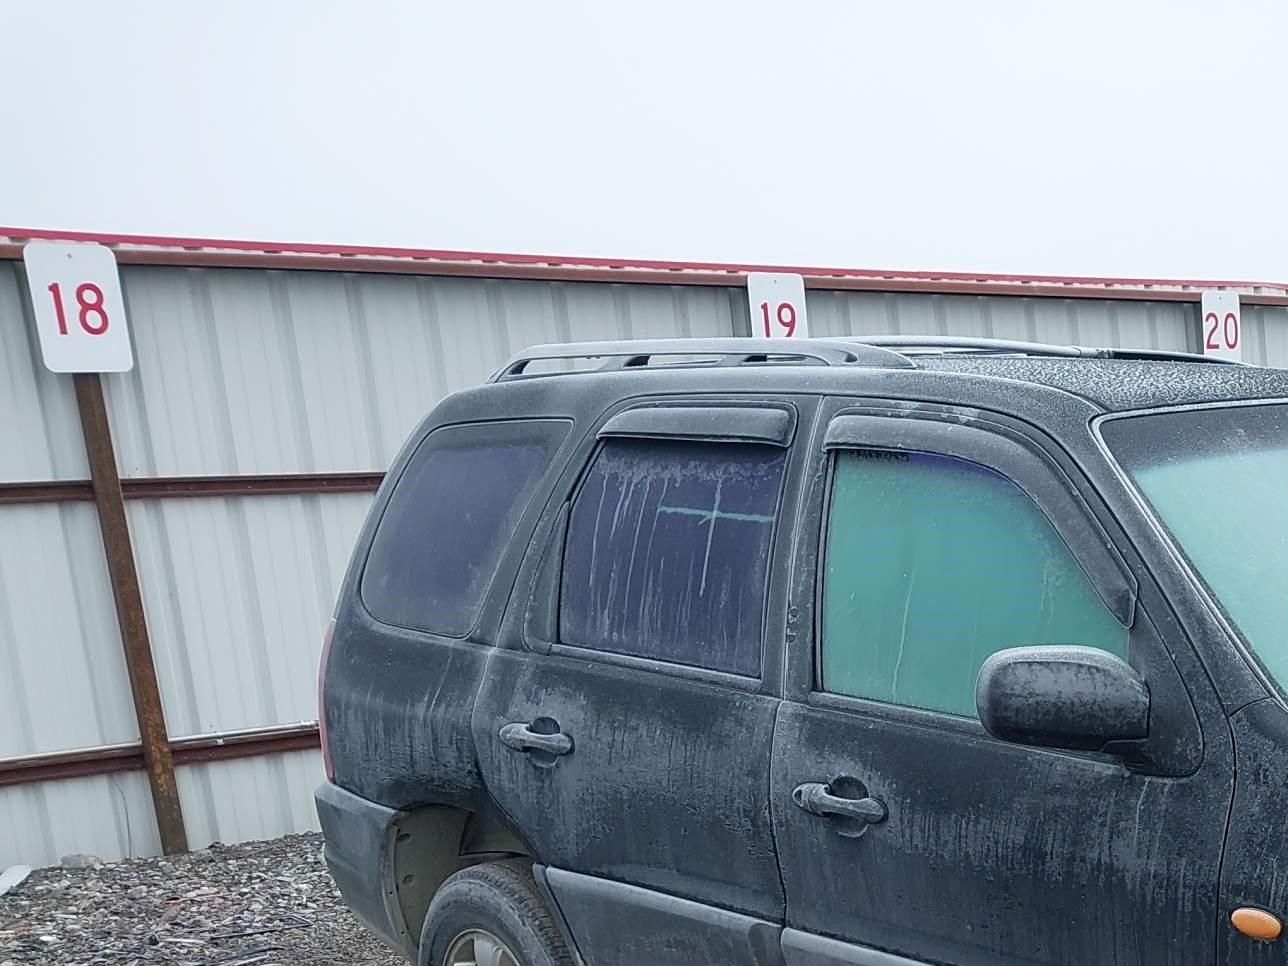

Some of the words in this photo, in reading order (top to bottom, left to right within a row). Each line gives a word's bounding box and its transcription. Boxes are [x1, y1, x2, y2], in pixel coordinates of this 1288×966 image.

[47, 282, 109, 335] 18
[760, 302, 796, 338] 19
[1205, 312, 1238, 349] 20
